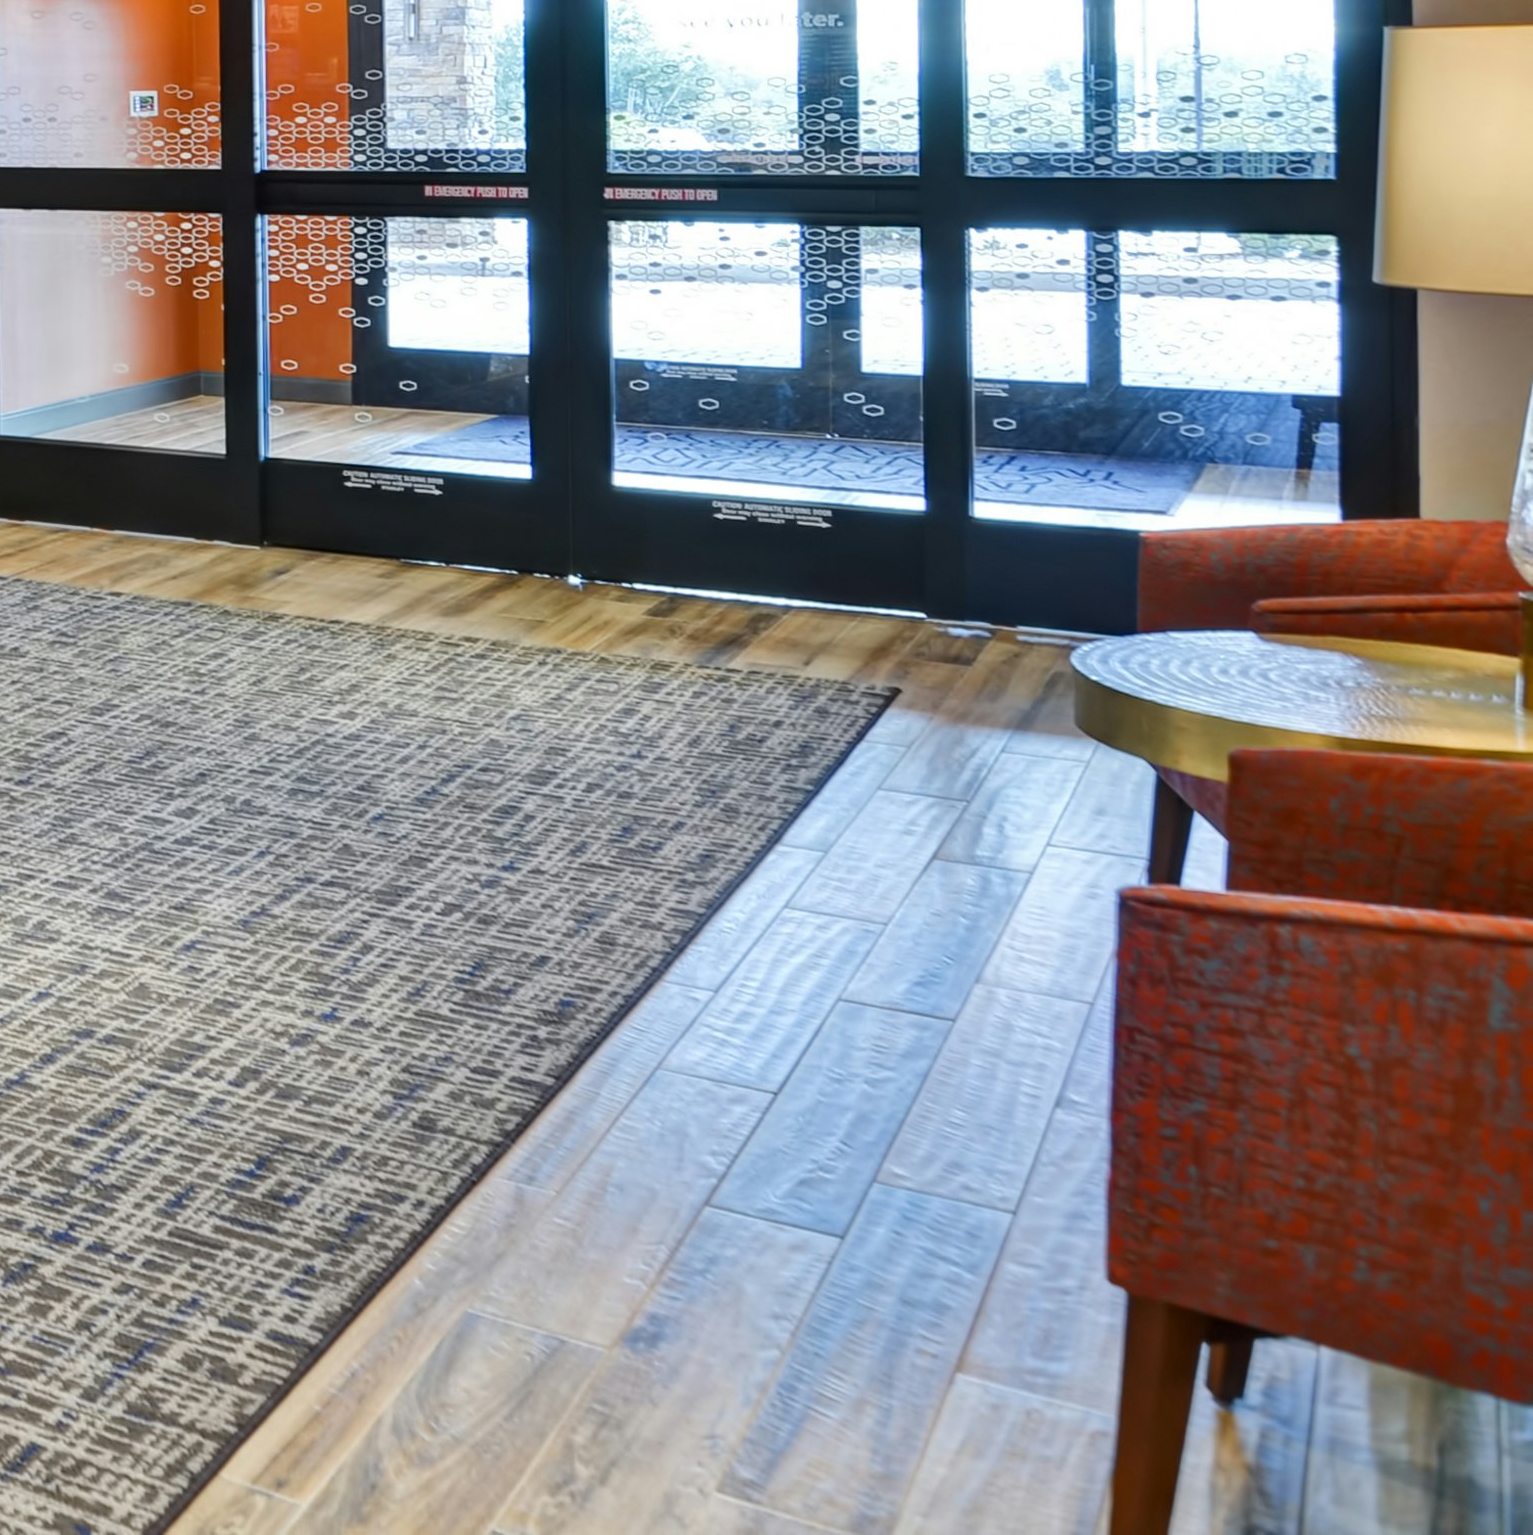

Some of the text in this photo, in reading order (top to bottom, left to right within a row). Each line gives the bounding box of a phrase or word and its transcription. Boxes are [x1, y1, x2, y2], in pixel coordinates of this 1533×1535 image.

[780, 12, 845, 28] lter.
[434, 185, 475, 197] EMERGENCY
[476, 186, 497, 198] PUSH
[498, 186, 508, 198] TO
[509, 187, 529, 198] OPEN
[615, 187, 660, 200] EMERGENCY
[661, 188, 682, 200] PUSH
[684, 188, 695, 201] TO
[696, 189, 718, 201] OPEN
